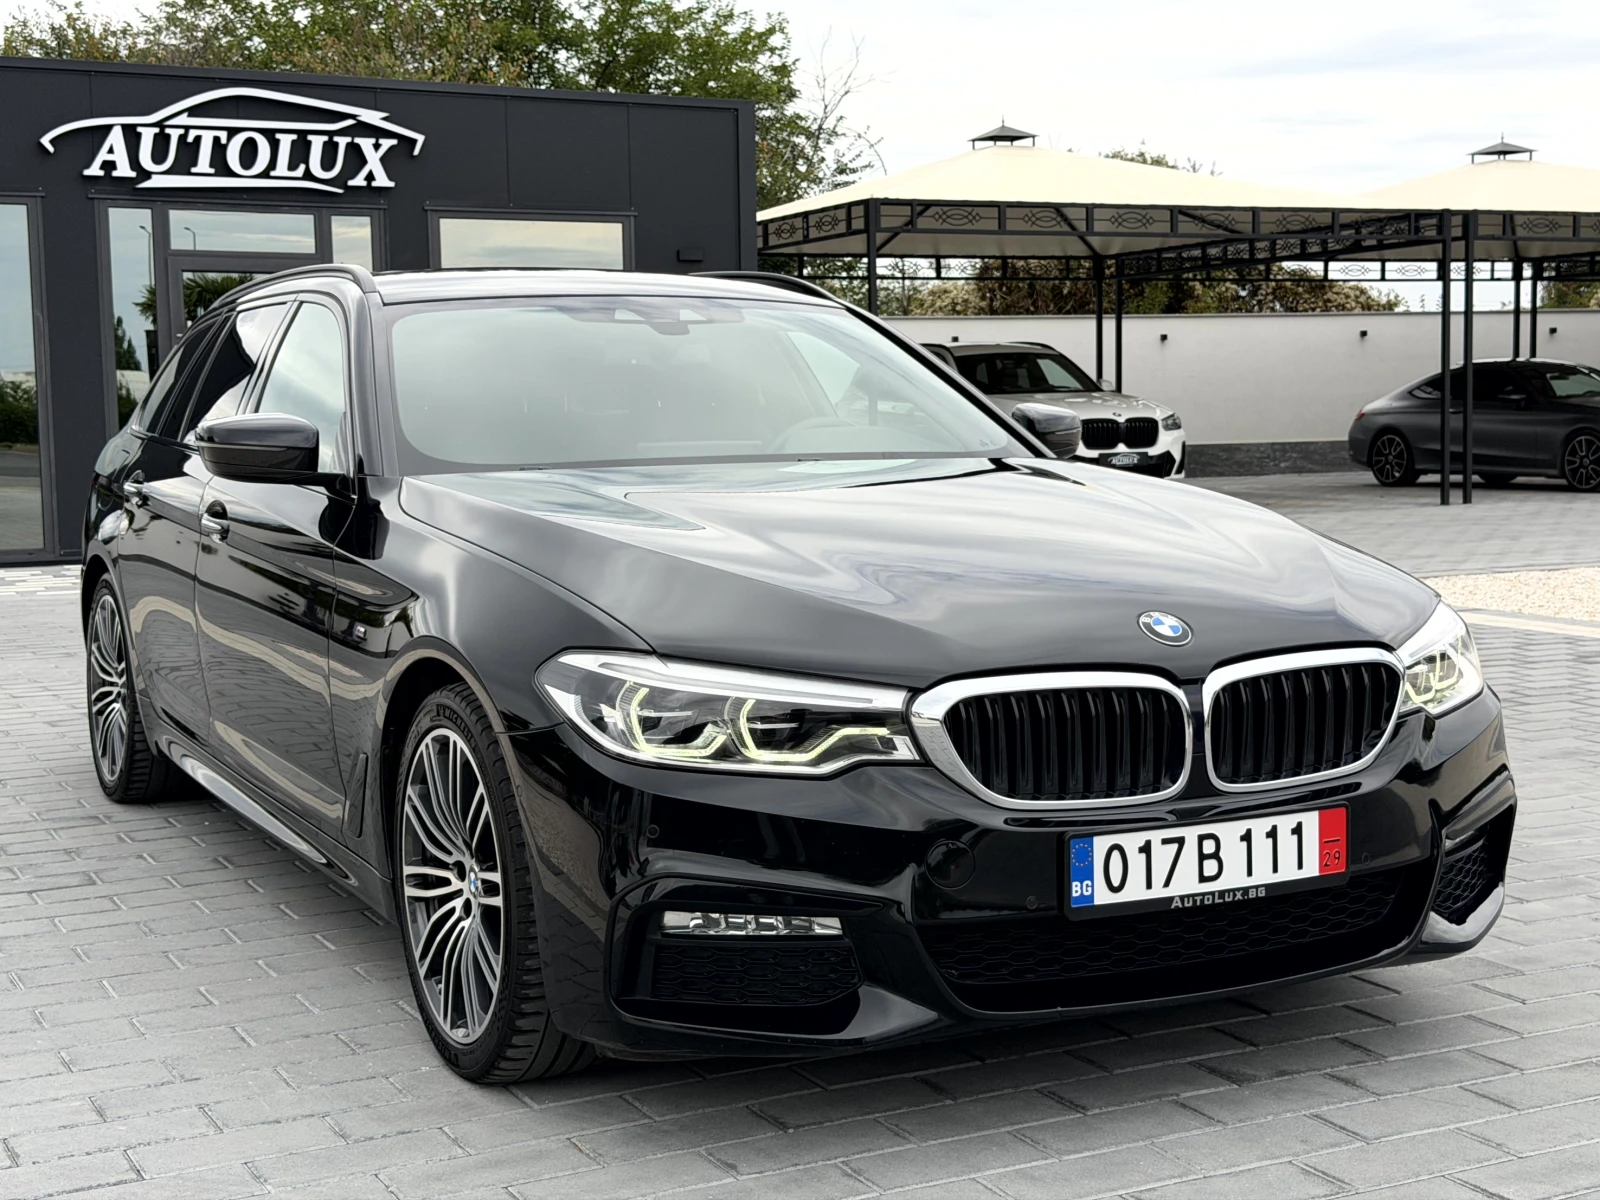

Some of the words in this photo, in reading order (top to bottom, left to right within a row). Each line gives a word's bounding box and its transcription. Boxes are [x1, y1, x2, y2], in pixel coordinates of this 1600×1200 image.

[83, 125, 398, 187] AUTOLUX
[443, 707, 477, 748] MICHELIN
[1323, 850, 1341, 867] 29
[1071, 881, 1093, 897] BG
